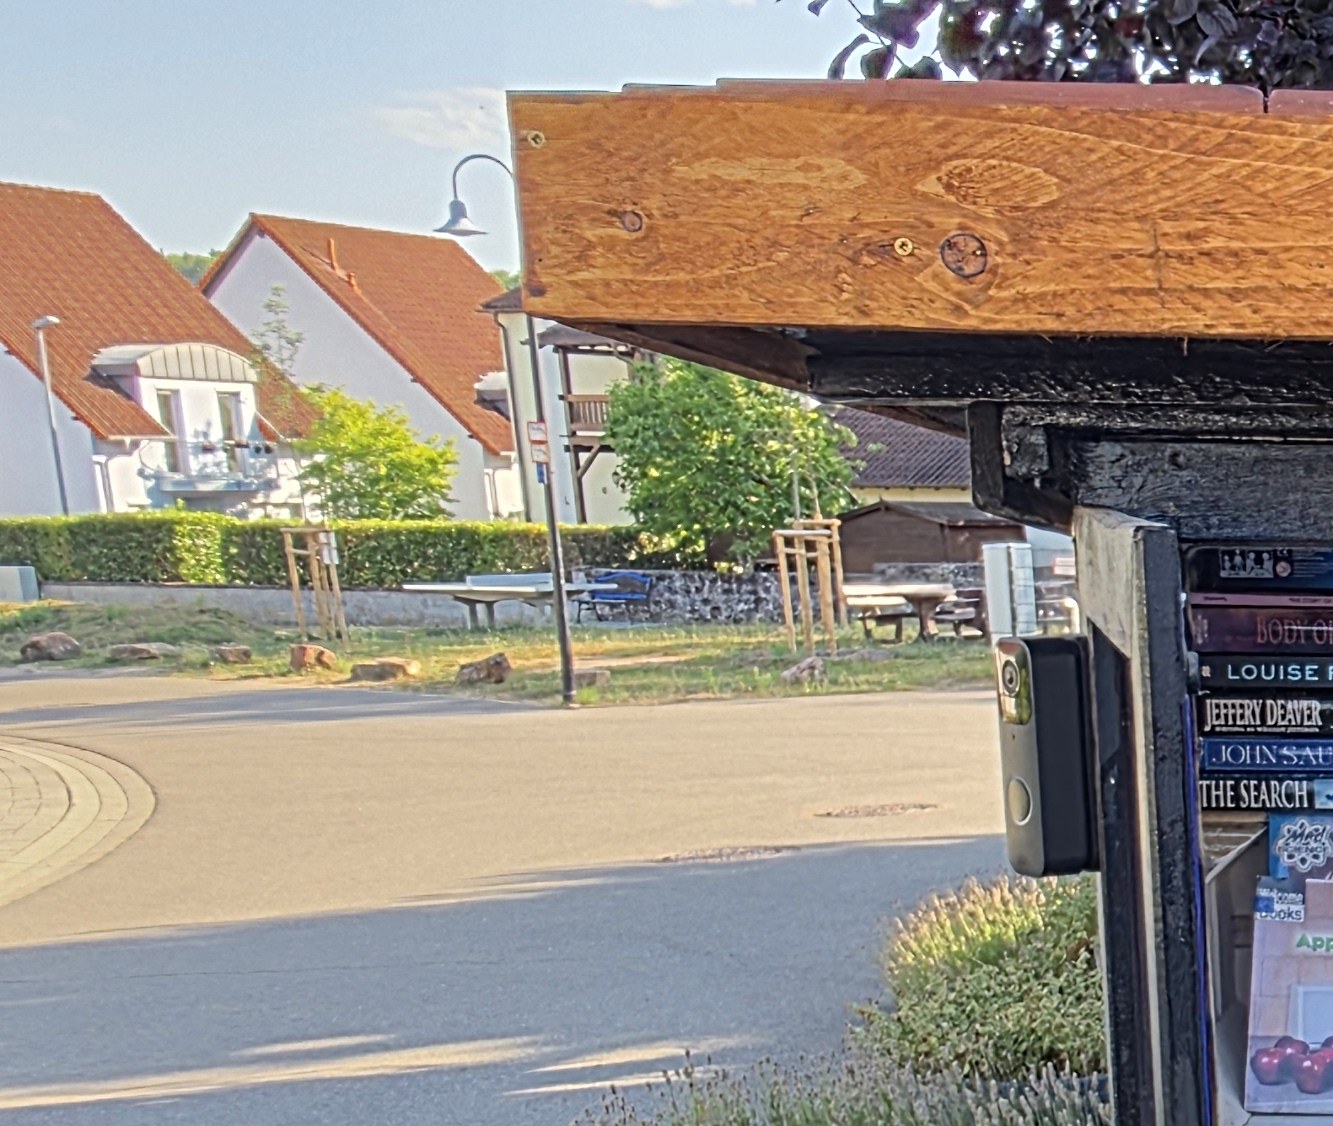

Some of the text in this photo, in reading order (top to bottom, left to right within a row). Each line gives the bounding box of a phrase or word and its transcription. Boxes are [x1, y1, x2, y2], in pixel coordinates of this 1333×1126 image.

[1257, 616, 1304, 644] BODY
[1313, 620, 1333, 644] OF
[1228, 665, 1318, 681] LOUISE
[1204, 700, 1322, 731] JEFFERY DEAVER
[1212, 745, 1276, 766] JOHN
[1199, 781, 1242, 808] THE
[1242, 781, 1309, 808] SEARCH
